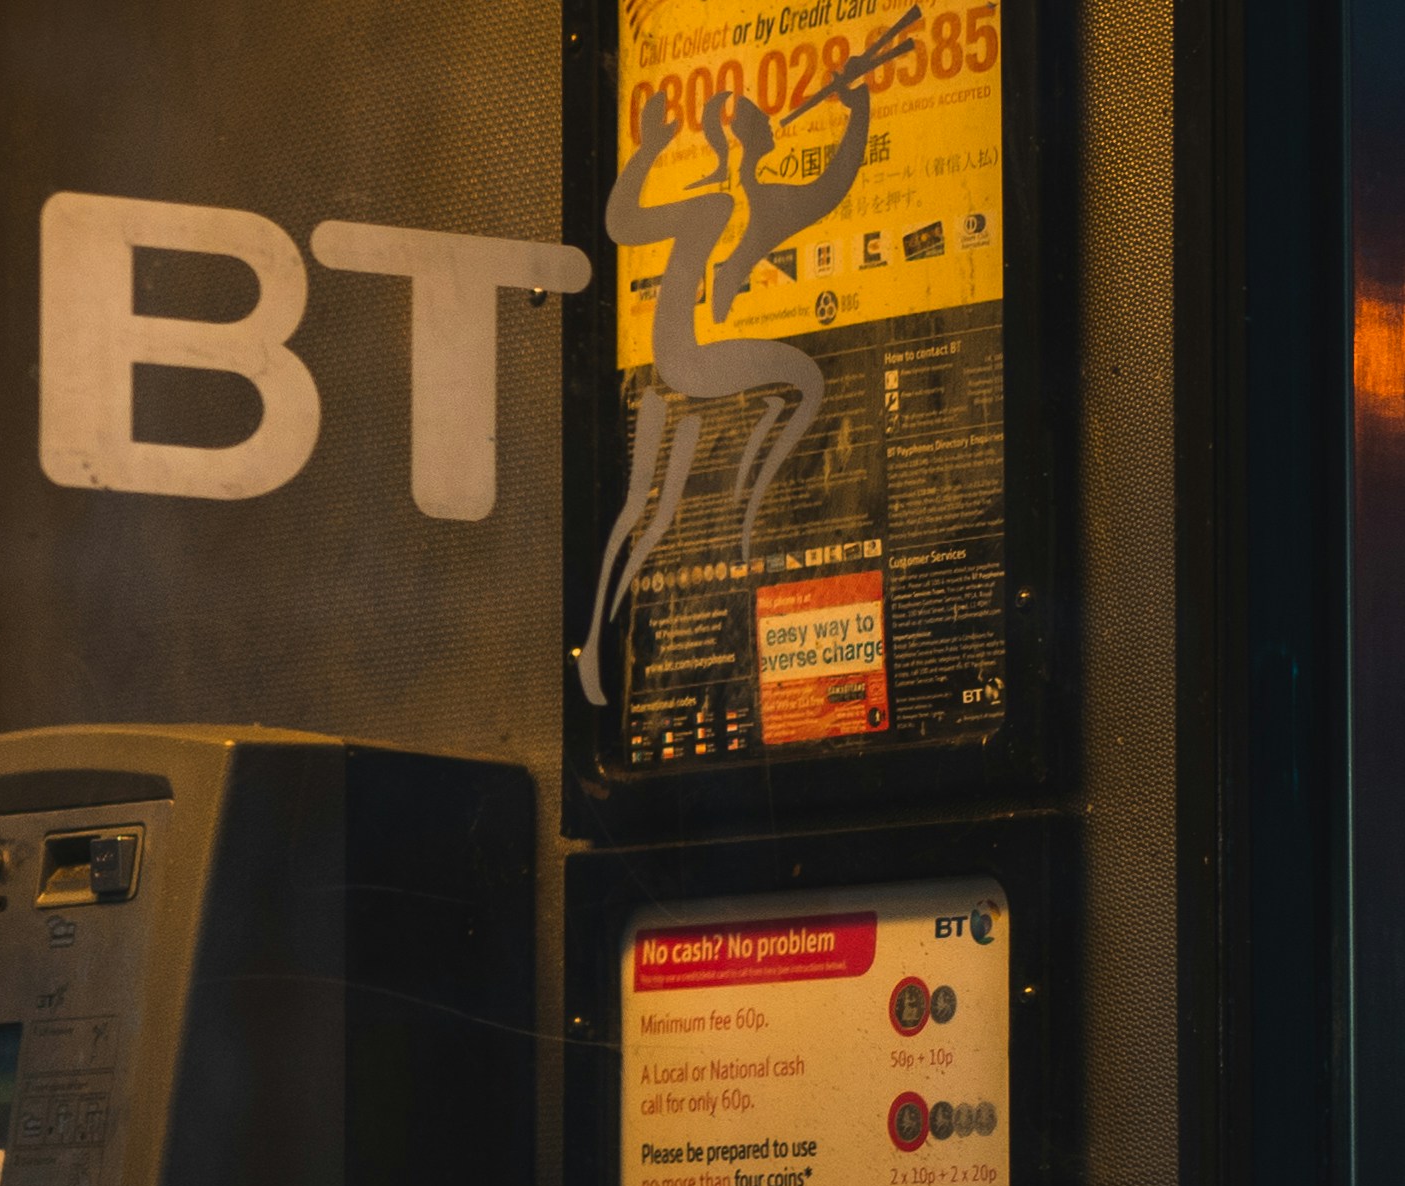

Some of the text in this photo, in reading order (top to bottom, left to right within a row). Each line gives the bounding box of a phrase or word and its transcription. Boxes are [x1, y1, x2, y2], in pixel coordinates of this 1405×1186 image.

[640, 38, 668, 68] Call
[672, 22, 729, 60] Collect
[733, 21, 752, 46] or
[755, 12, 775, 45] by
[779, 0, 831, 35] Credit
[39, 190, 593, 522] BT
[885, 340, 962, 365] How to contact BT
[935, 438, 970, 451] Directory
[889, 548, 967, 569] Customer Services
[766, 614, 874, 647] easy way to
[963, 688, 984, 704] BT
[934, 915, 968, 939] BT
[642, 928, 835, 966] No cash? No problem
[640, 1007, 770, 1037] Minimum fee 60p.
[641, 1055, 805, 1084] A Local or National cash
[890, 1050, 915, 1070] 50p
[930, 1048, 953, 1068] 10p
[641, 1089, 755, 1118] call for only 60p.
[641, 1138, 818, 1168] Please be prepared to use
[890, 1168, 899, 1185] 2
[949, 1166, 959, 1183] 2
[971, 1163, 997, 1185] 20p
